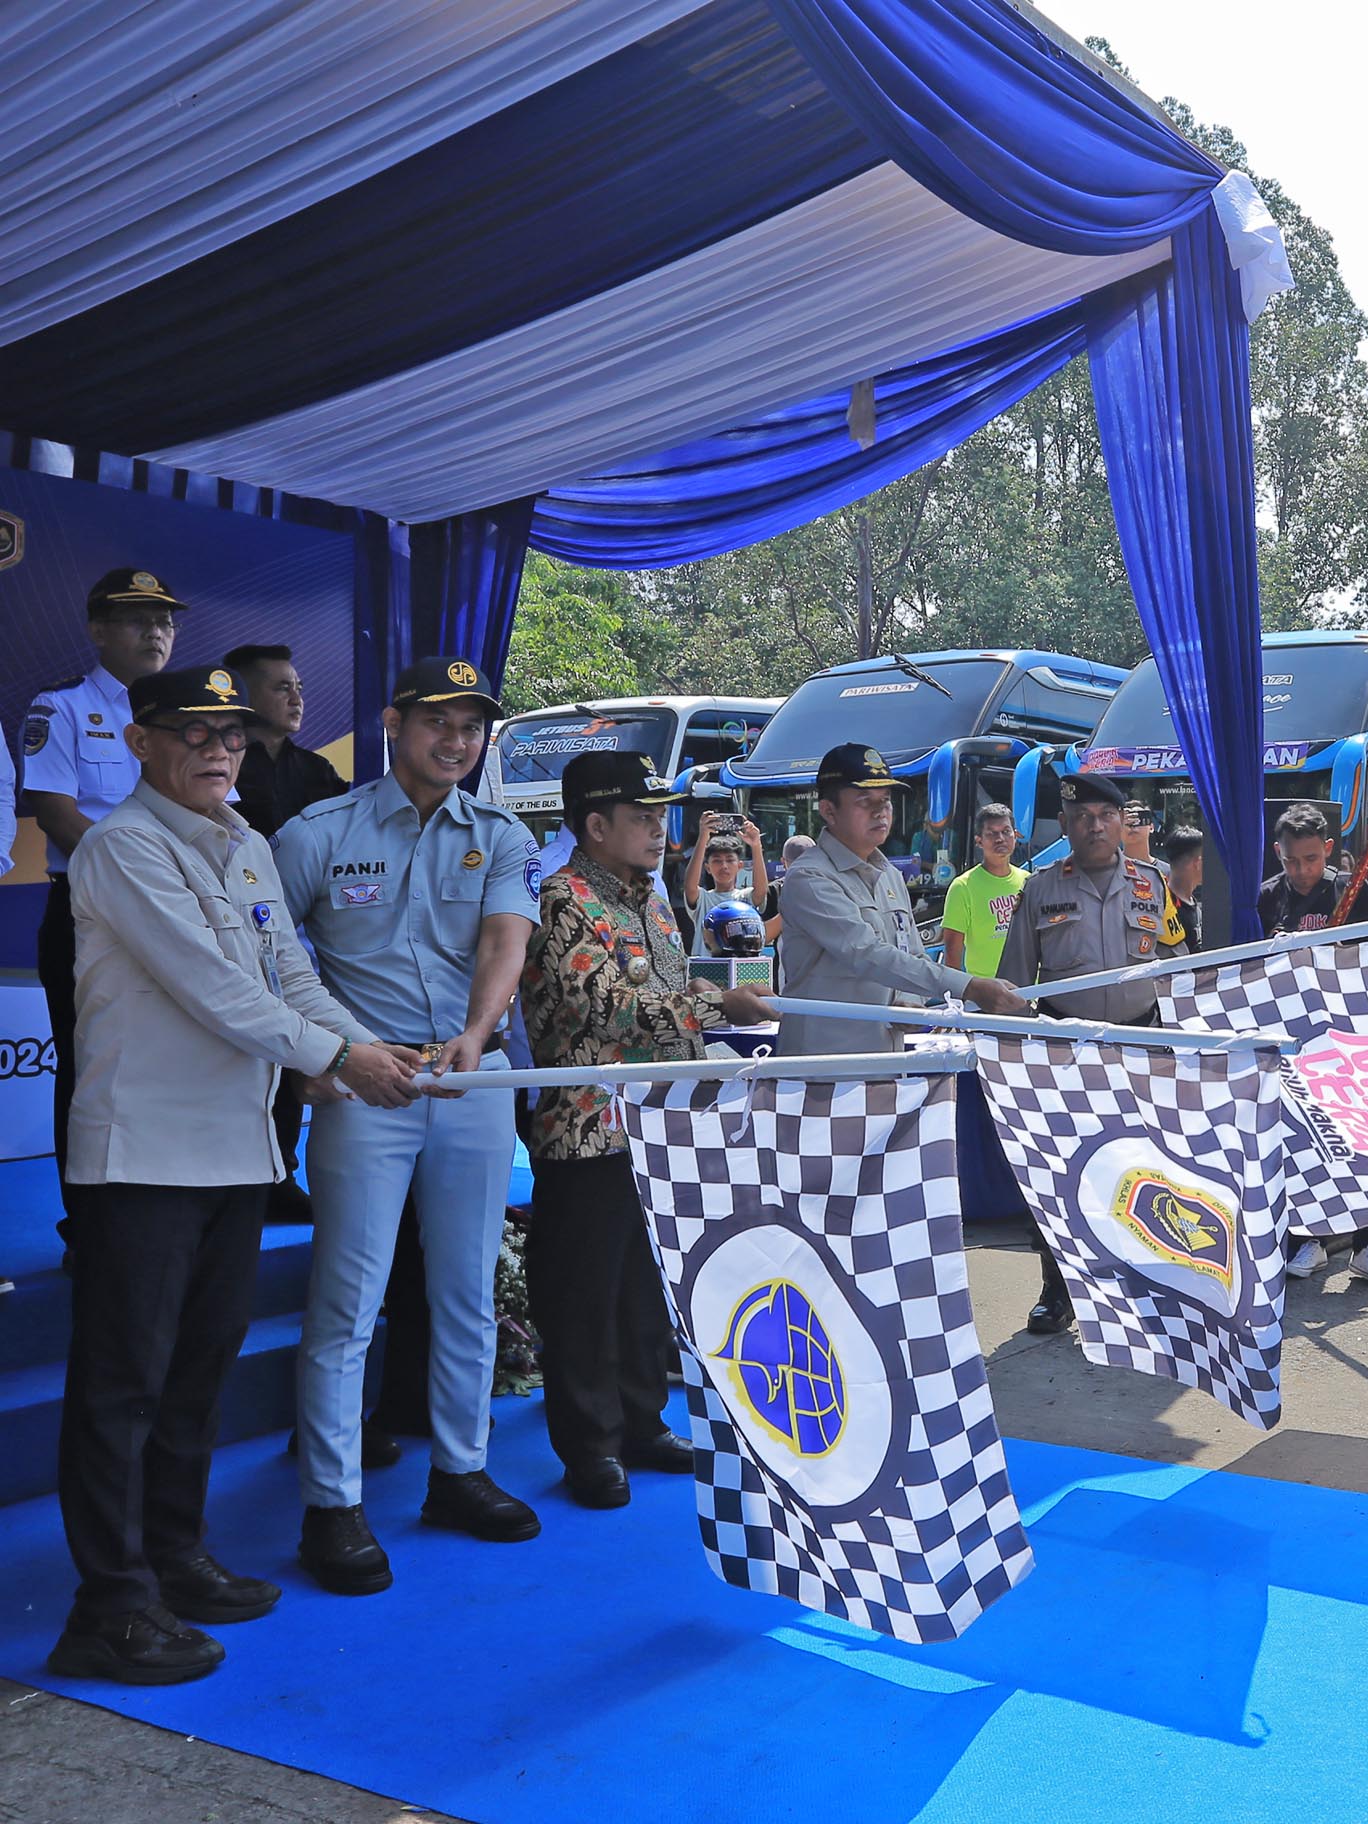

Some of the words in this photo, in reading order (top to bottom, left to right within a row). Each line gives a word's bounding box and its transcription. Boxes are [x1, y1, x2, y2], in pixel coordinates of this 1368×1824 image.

[844, 684, 914, 696] PARIWISATA
[532, 723, 589, 737] JETBUS
[510, 736, 619, 758] PARIWISATA
[526, 800, 541, 809] THE
[542, 799, 558, 808] BUS
[332, 860, 386, 878] PANJI
[1130, 901, 1159, 914] POLRI
[1127, 1222, 1161, 1252] NYAMAN
